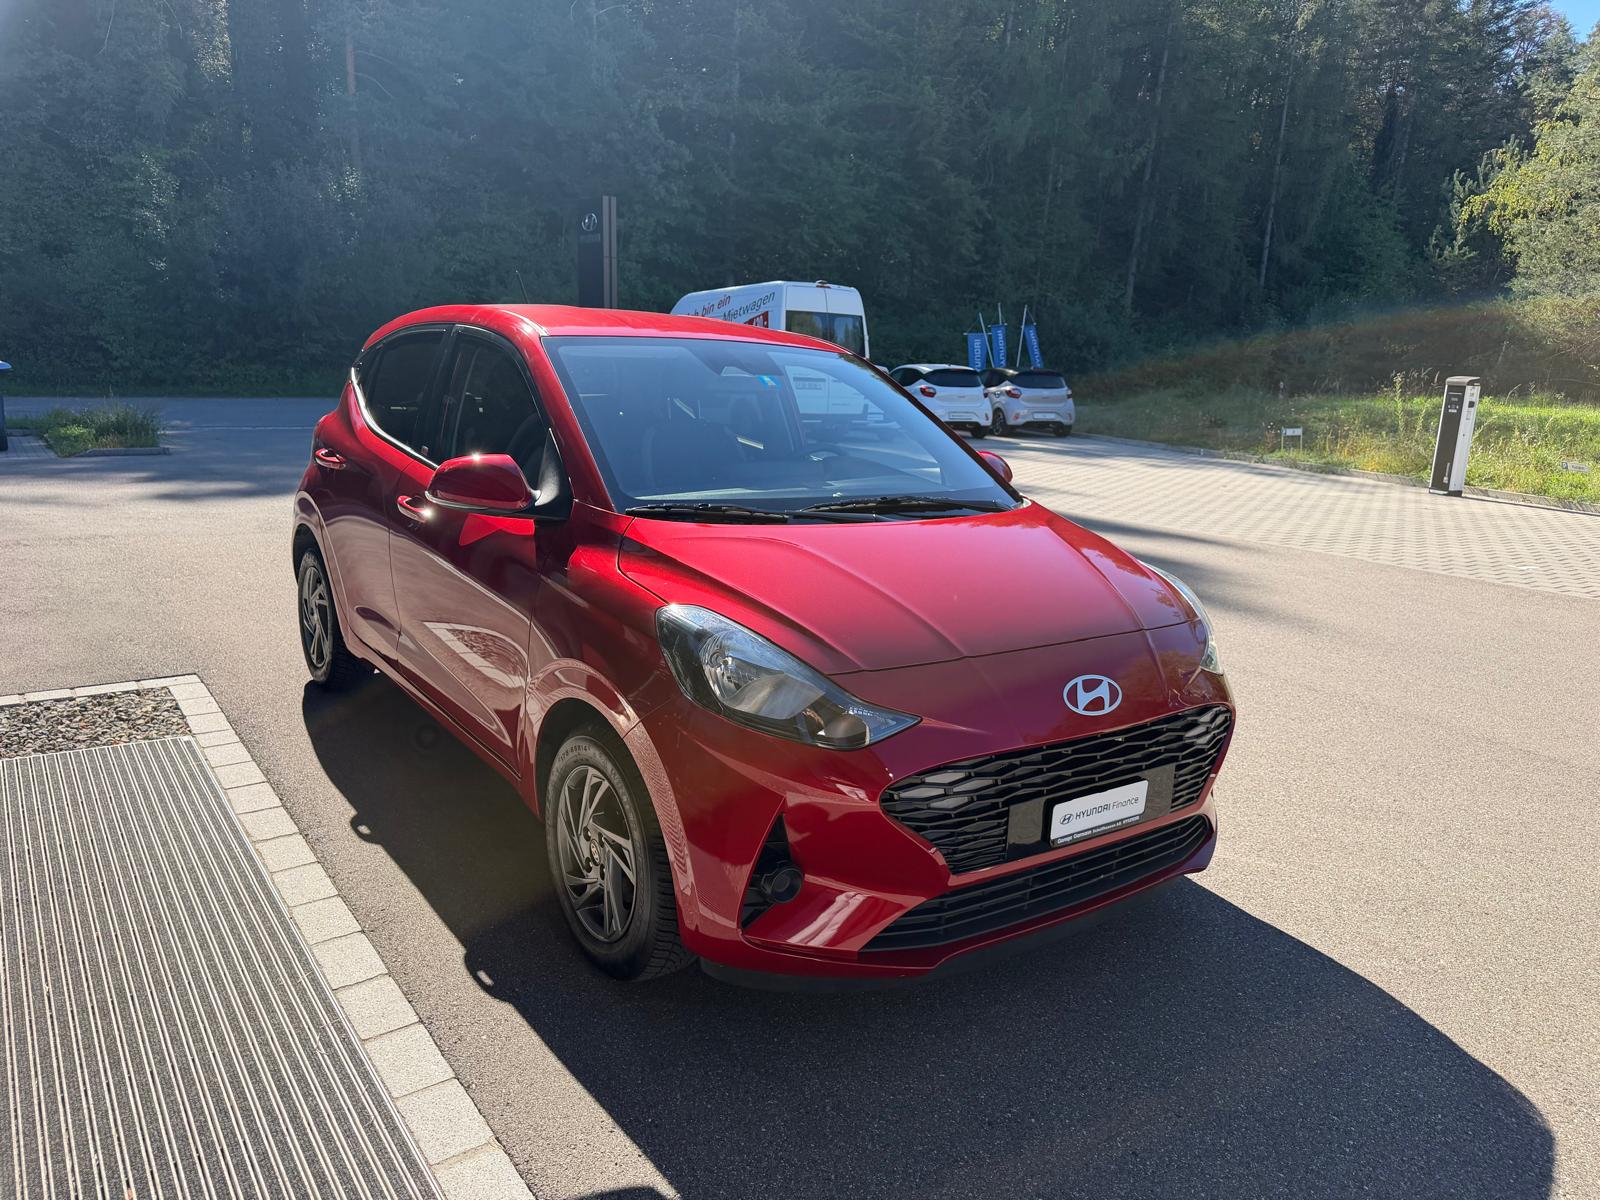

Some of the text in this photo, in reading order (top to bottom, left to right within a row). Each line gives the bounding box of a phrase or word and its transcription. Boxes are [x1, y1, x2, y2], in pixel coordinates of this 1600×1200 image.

[701, 303, 714, 317] bin
[717, 295, 731, 309] ein
[723, 292, 776, 321] Mietwagen
[1075, 797, 1140, 820] HYUNDAI Finance
